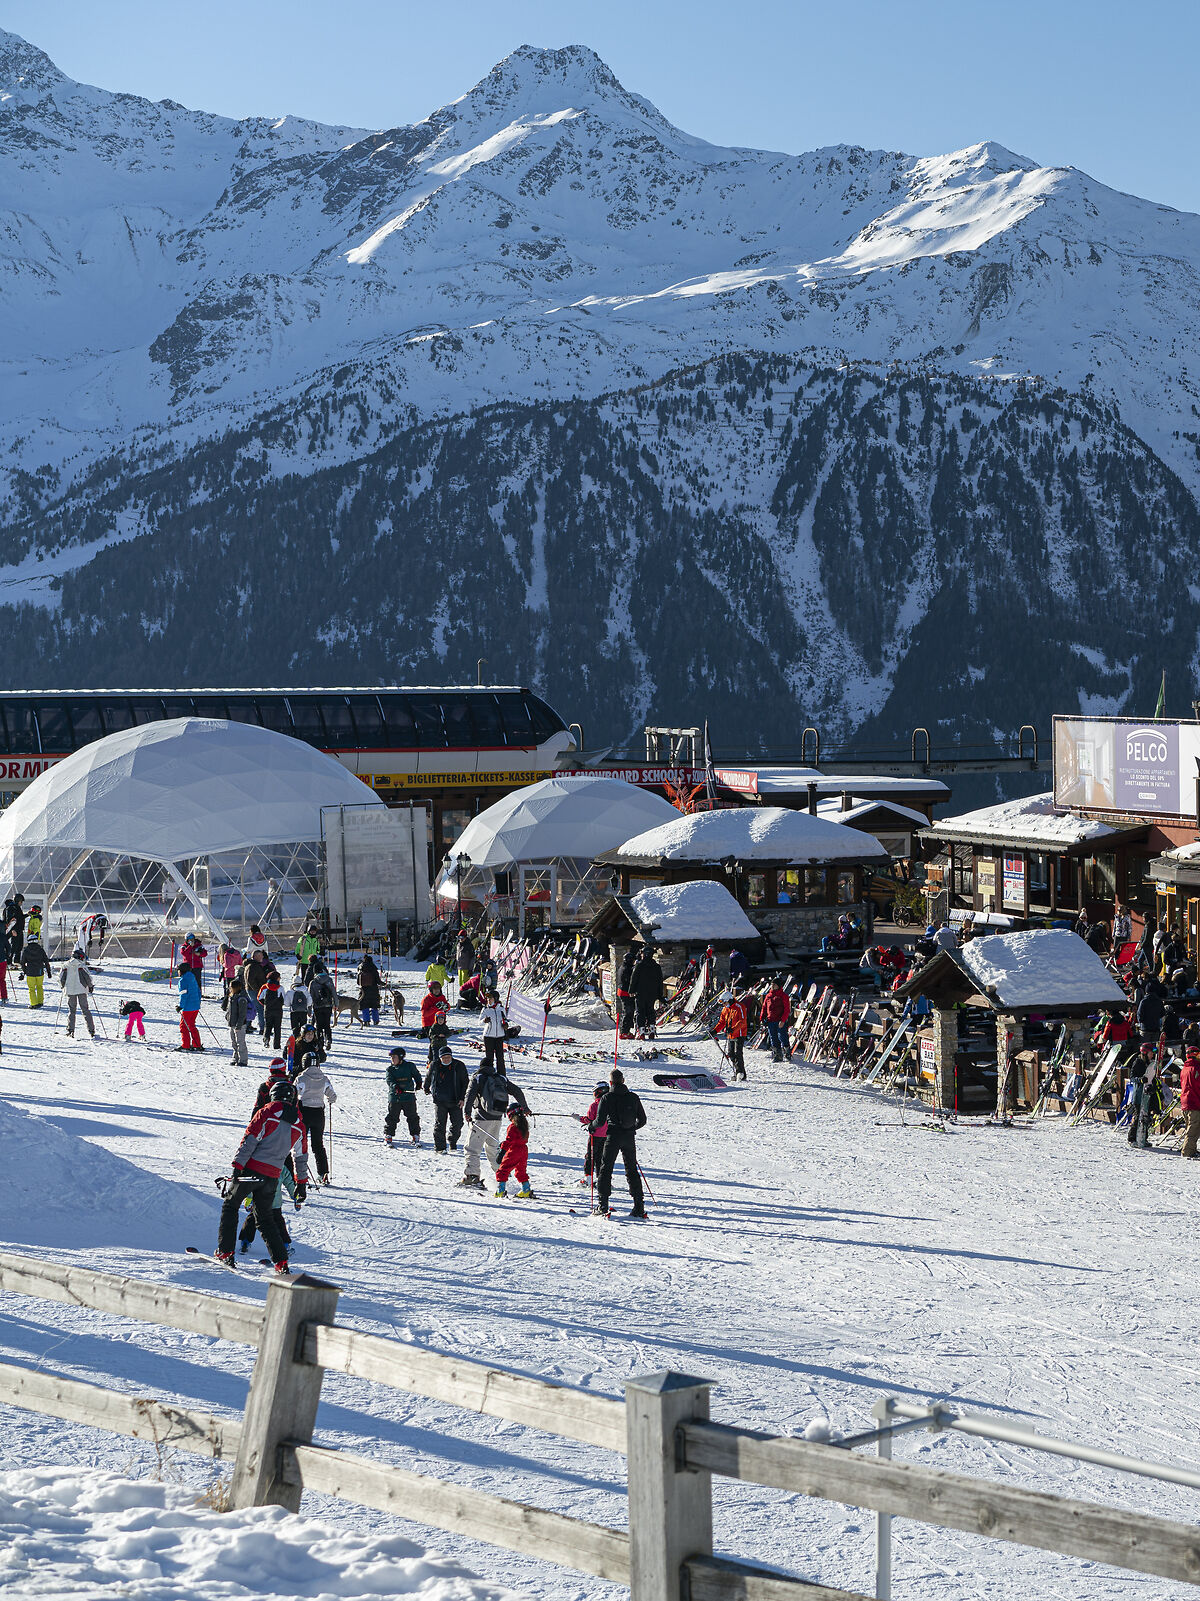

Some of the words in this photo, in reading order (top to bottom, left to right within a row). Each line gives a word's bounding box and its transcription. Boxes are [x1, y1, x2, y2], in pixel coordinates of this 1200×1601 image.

[1126, 742, 1168, 762] PELCO
[407, 771, 535, 784] BIGLIETTERIA-TICKETS-KASSE
[642, 768, 685, 783] SCHOOLS
